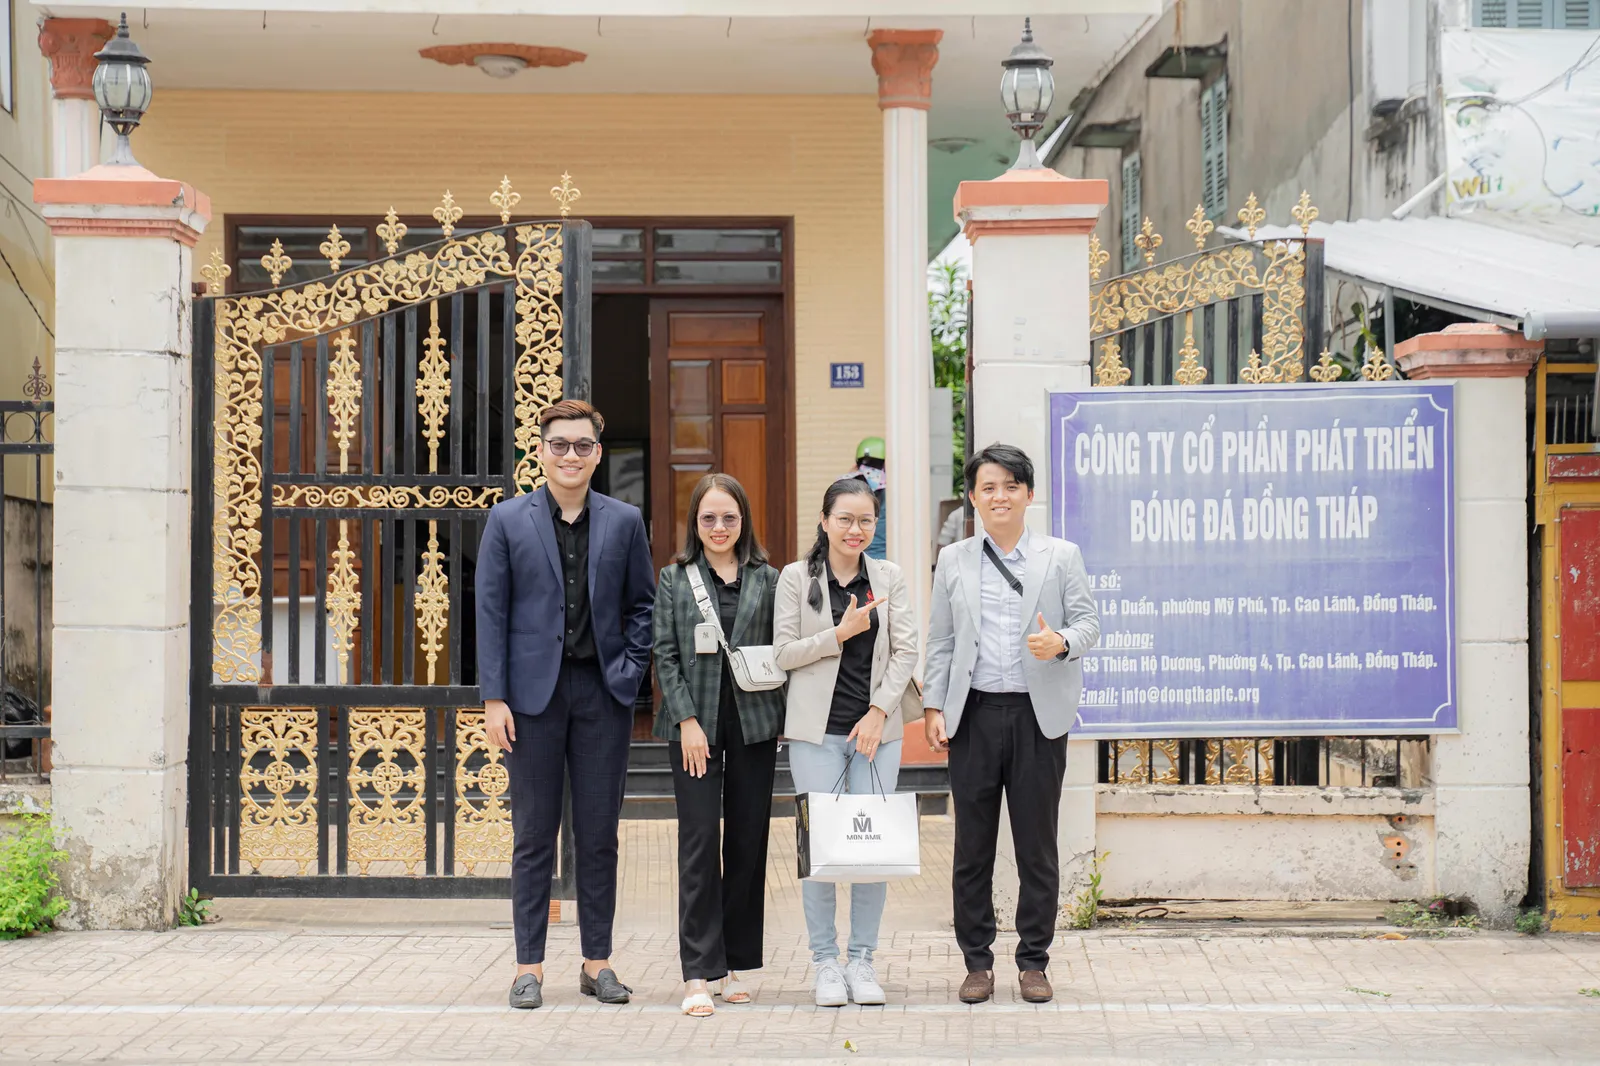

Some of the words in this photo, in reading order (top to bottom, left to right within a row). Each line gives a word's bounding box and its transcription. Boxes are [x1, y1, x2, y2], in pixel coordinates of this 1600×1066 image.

[836, 365, 860, 380] 153
[1075, 423, 1141, 475] CÔNG
[1148, 431, 1176, 474] TY
[1183, 413, 1216, 474] CỔ
[1222, 414, 1288, 473] PHẦN
[1296, 418, 1357, 472] PHÁT
[1363, 408, 1434, 470] TRIỂN
[1130, 490, 1196, 542] BÓNG
[1203, 489, 1236, 541] ĐÁ
[1242, 482, 1309, 540] ĐỒNG
[1316, 486, 1378, 539] THÁP
[1100, 569, 1121, 589] sở:
[1102, 599, 1117, 616] Lê
[1162, 598, 1210, 617] phường
[1214, 597, 1234, 615] Mỹ
[1238, 595, 1267, 615] Phú,
[1271, 597, 1291, 614] Tp.
[1295, 596, 1320, 613] Cao
[1324, 595, 1360, 613] Lãnh,
[1363, 593, 1397, 613] Đồng
[1401, 594, 1437, 613] Tháp.
[1105, 630, 1154, 649] phòng:
[1082, 656, 1099, 673] 53
[1102, 656, 1137, 673] Thiên
[1141, 656, 1158, 674] Hộ
[1161, 655, 1205, 673] Dương,
[1209, 654, 1257, 672] Phường
[1260, 654, 1273, 671] 4,
[1276, 653, 1295, 671] Tp.
[1299, 653, 1323, 669] Cao
[1327, 652, 1362, 670] Lãnh,
[1365, 650, 1399, 669] Đồng
[1402, 651, 1438, 669] Tháp.
[1079, 687, 1119, 704] Email:
[1121, 686, 1260, 704] info@dongthapfc.org
